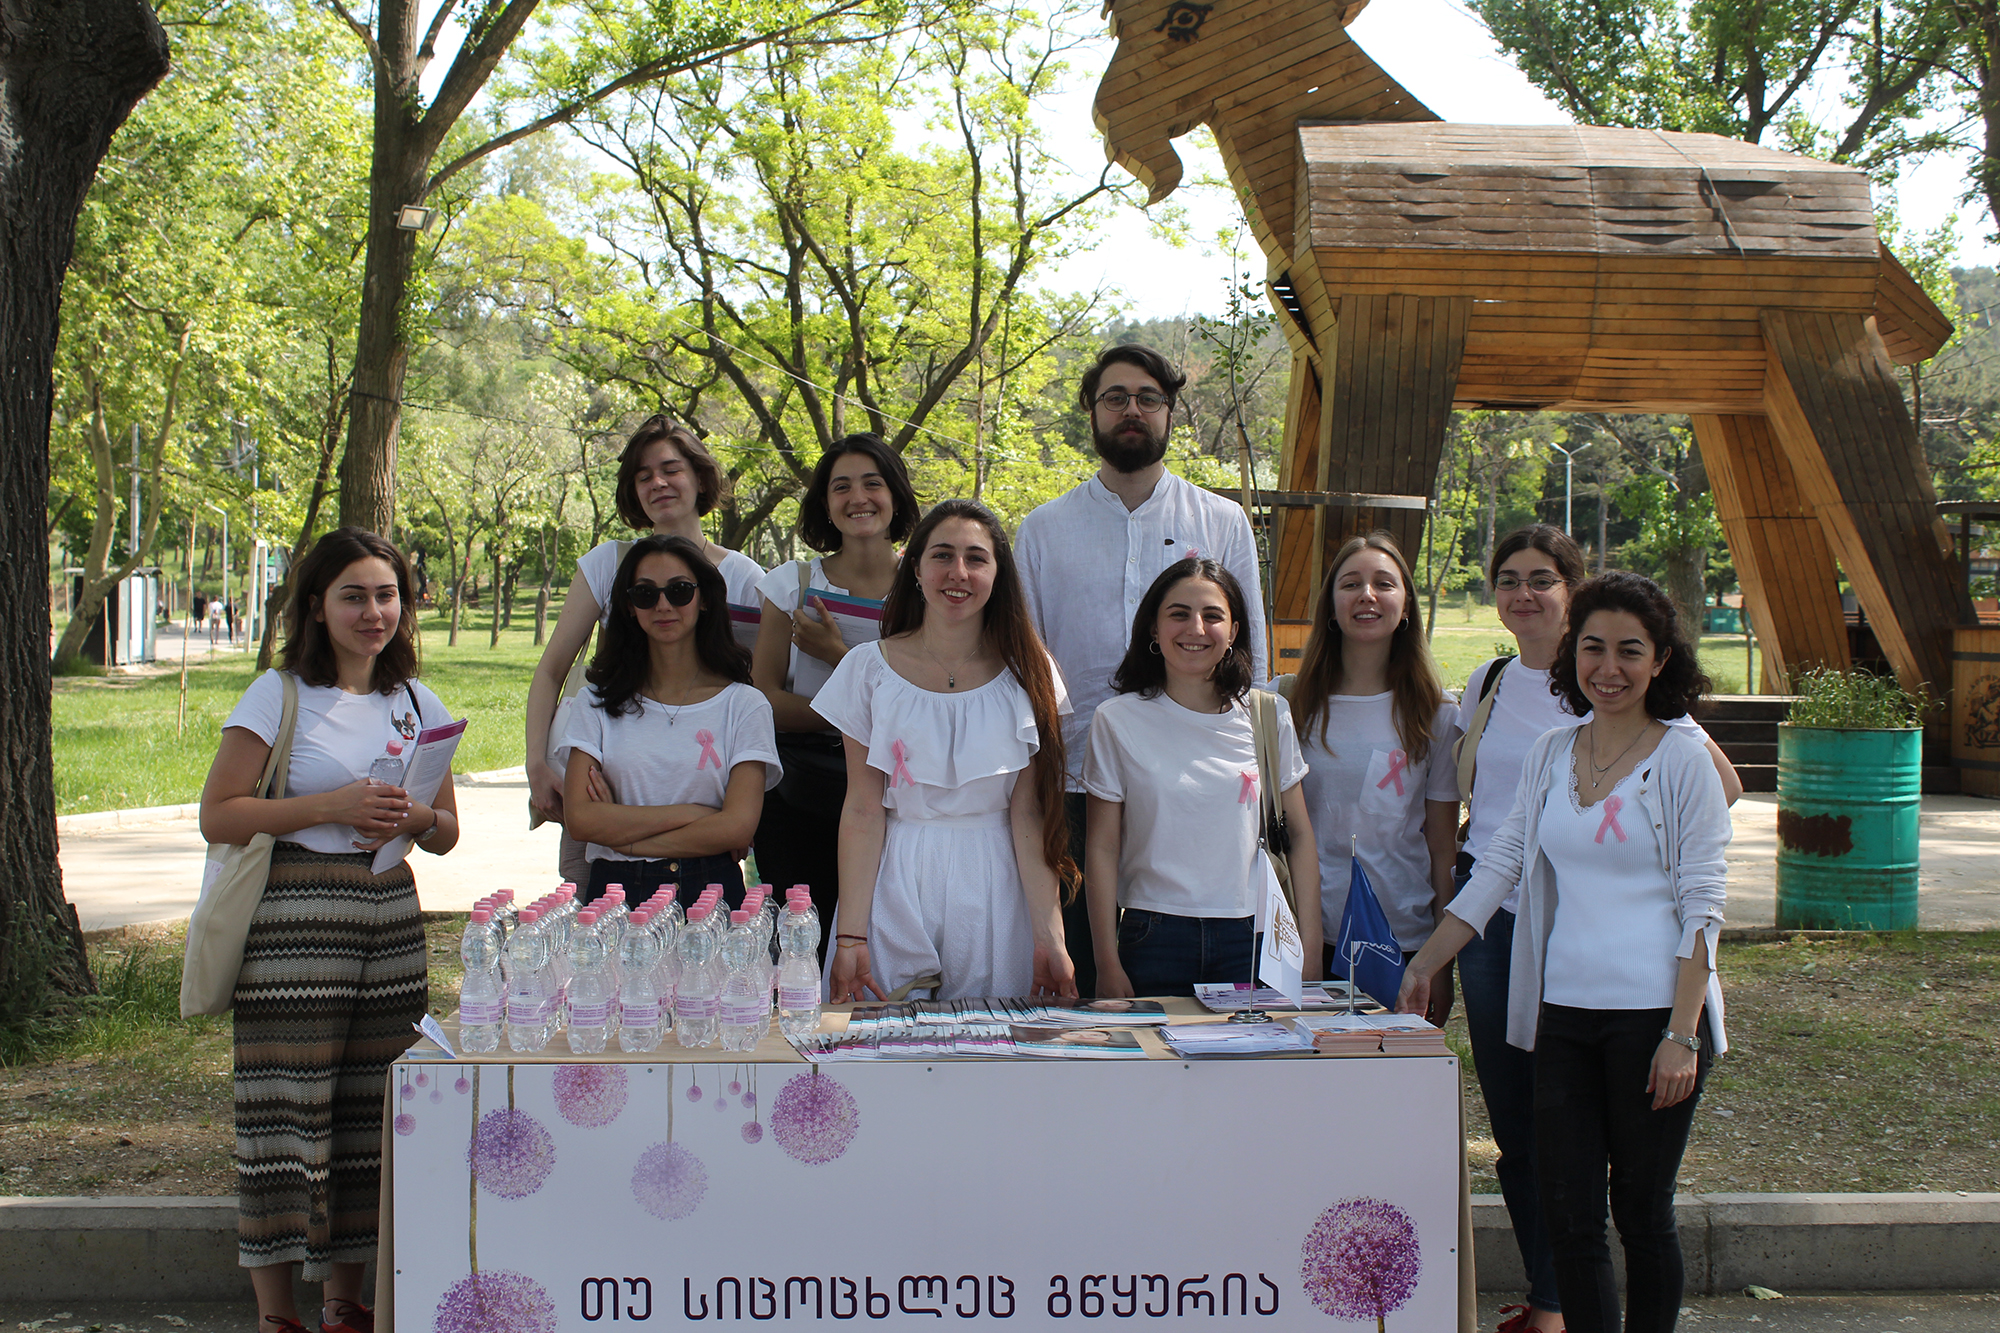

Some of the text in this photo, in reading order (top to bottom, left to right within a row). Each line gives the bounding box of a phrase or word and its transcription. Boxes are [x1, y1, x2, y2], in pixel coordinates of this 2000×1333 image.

[580, 1272, 1279, 1322] თუ სიცოცხლეც გწყურია
